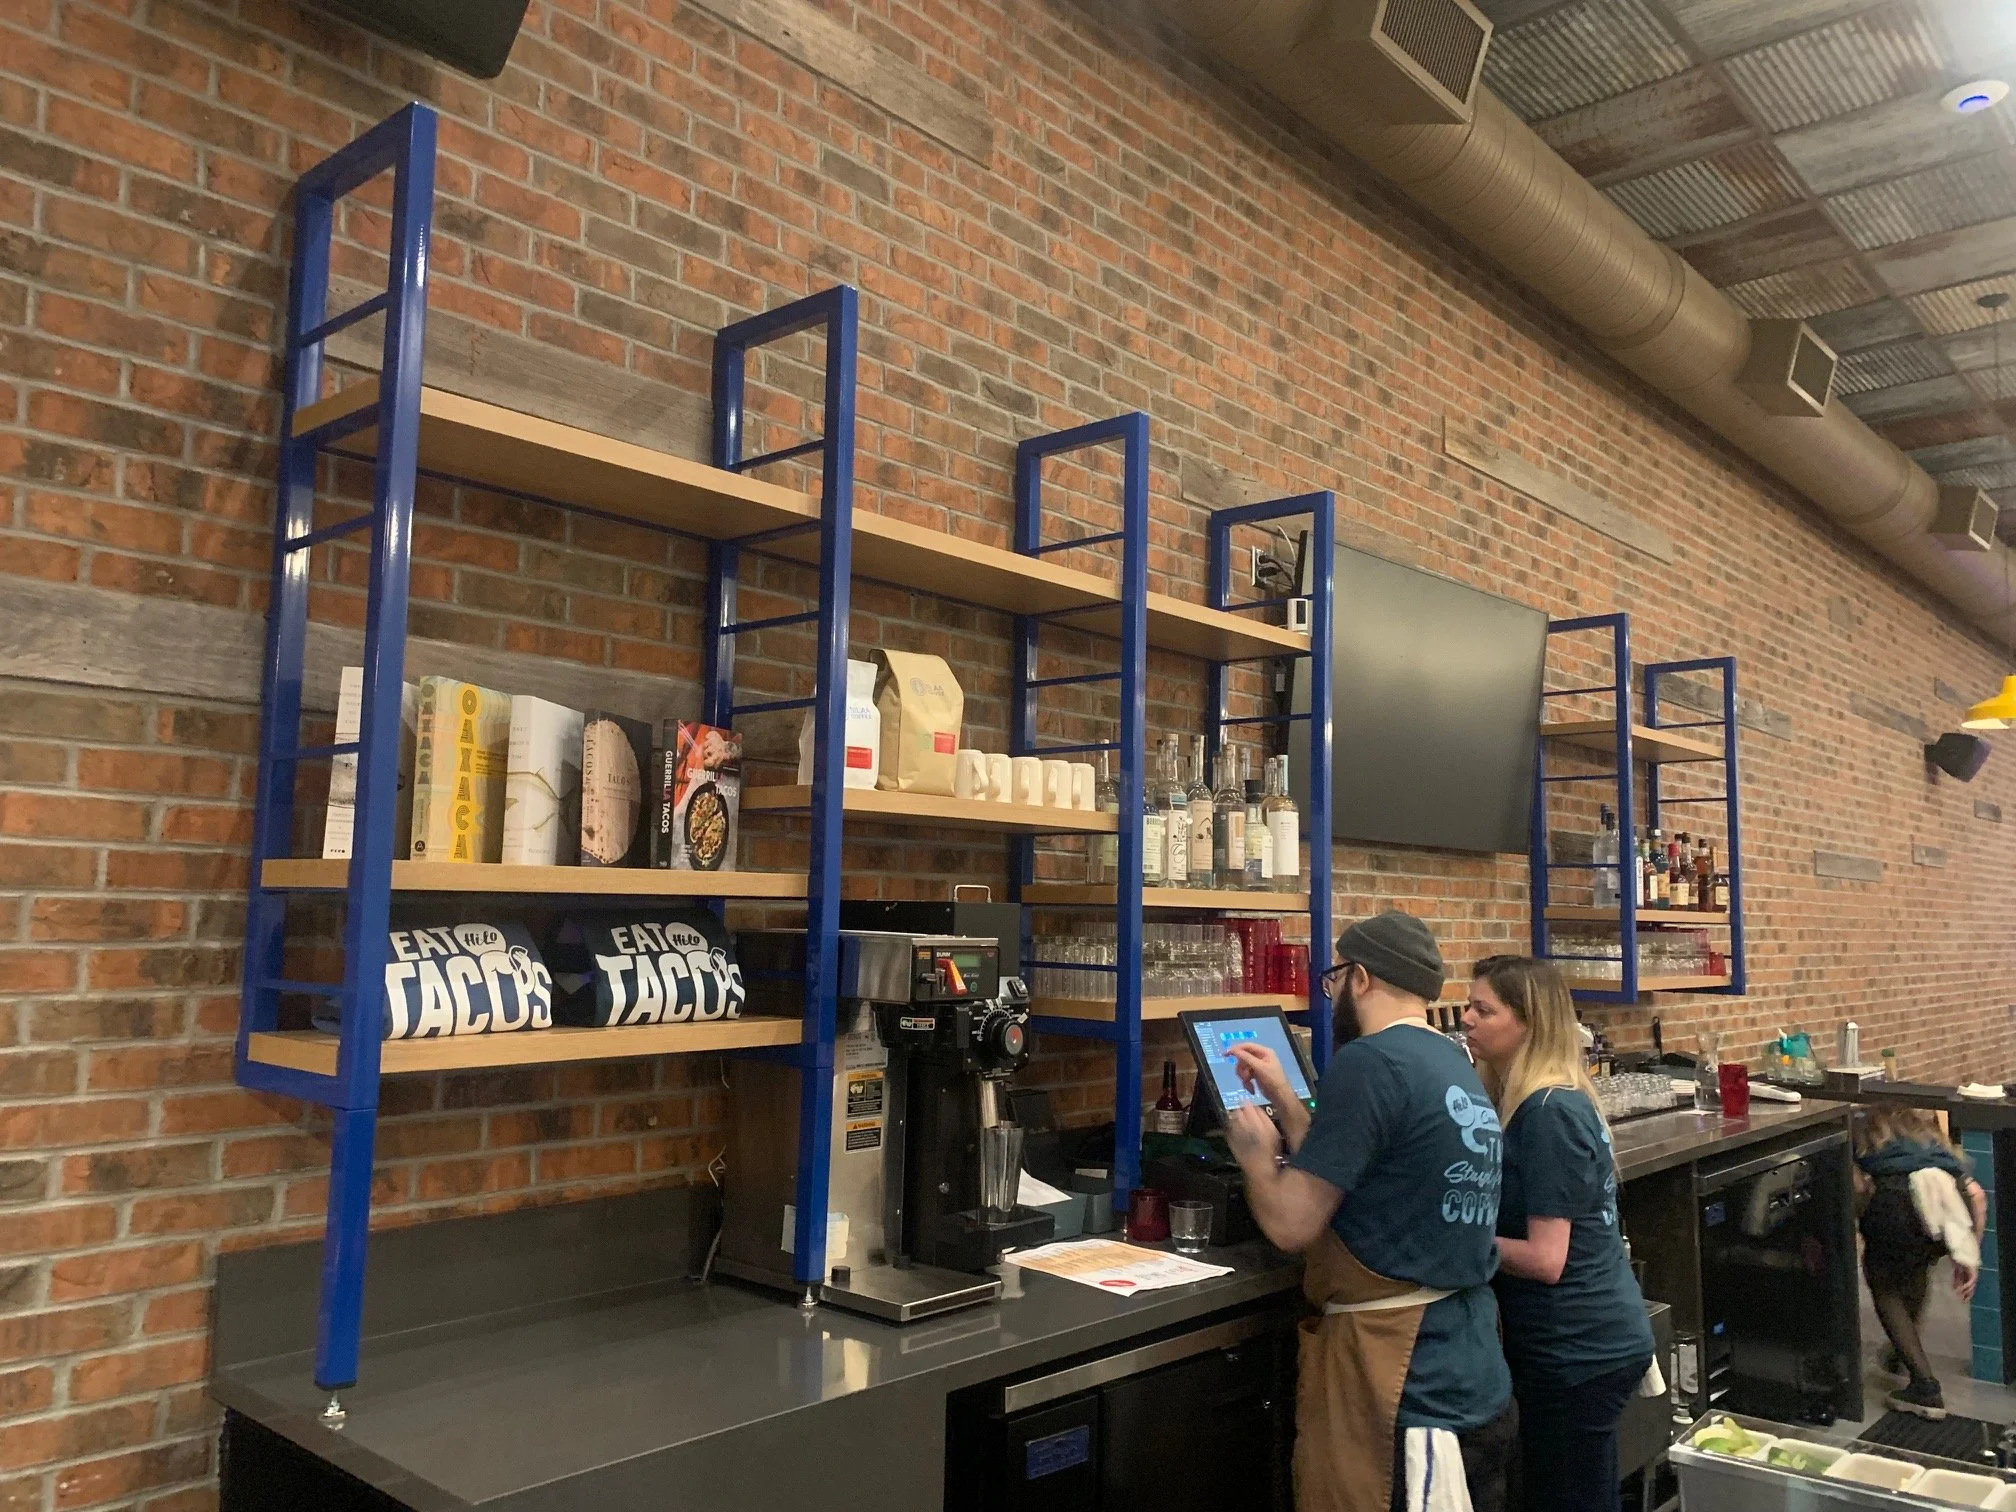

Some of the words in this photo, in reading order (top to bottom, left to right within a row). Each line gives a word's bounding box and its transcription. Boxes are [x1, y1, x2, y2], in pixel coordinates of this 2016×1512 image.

[662, 750, 673, 801] GUERRILLA
[715, 784, 737, 798] TACOS
[661, 802, 671, 834] TACOS
[389, 926, 460, 962] EAT
[610, 922, 670, 954] EAT
[385, 948, 553, 1040] TACOS
[595, 949, 746, 1026] TACOS
